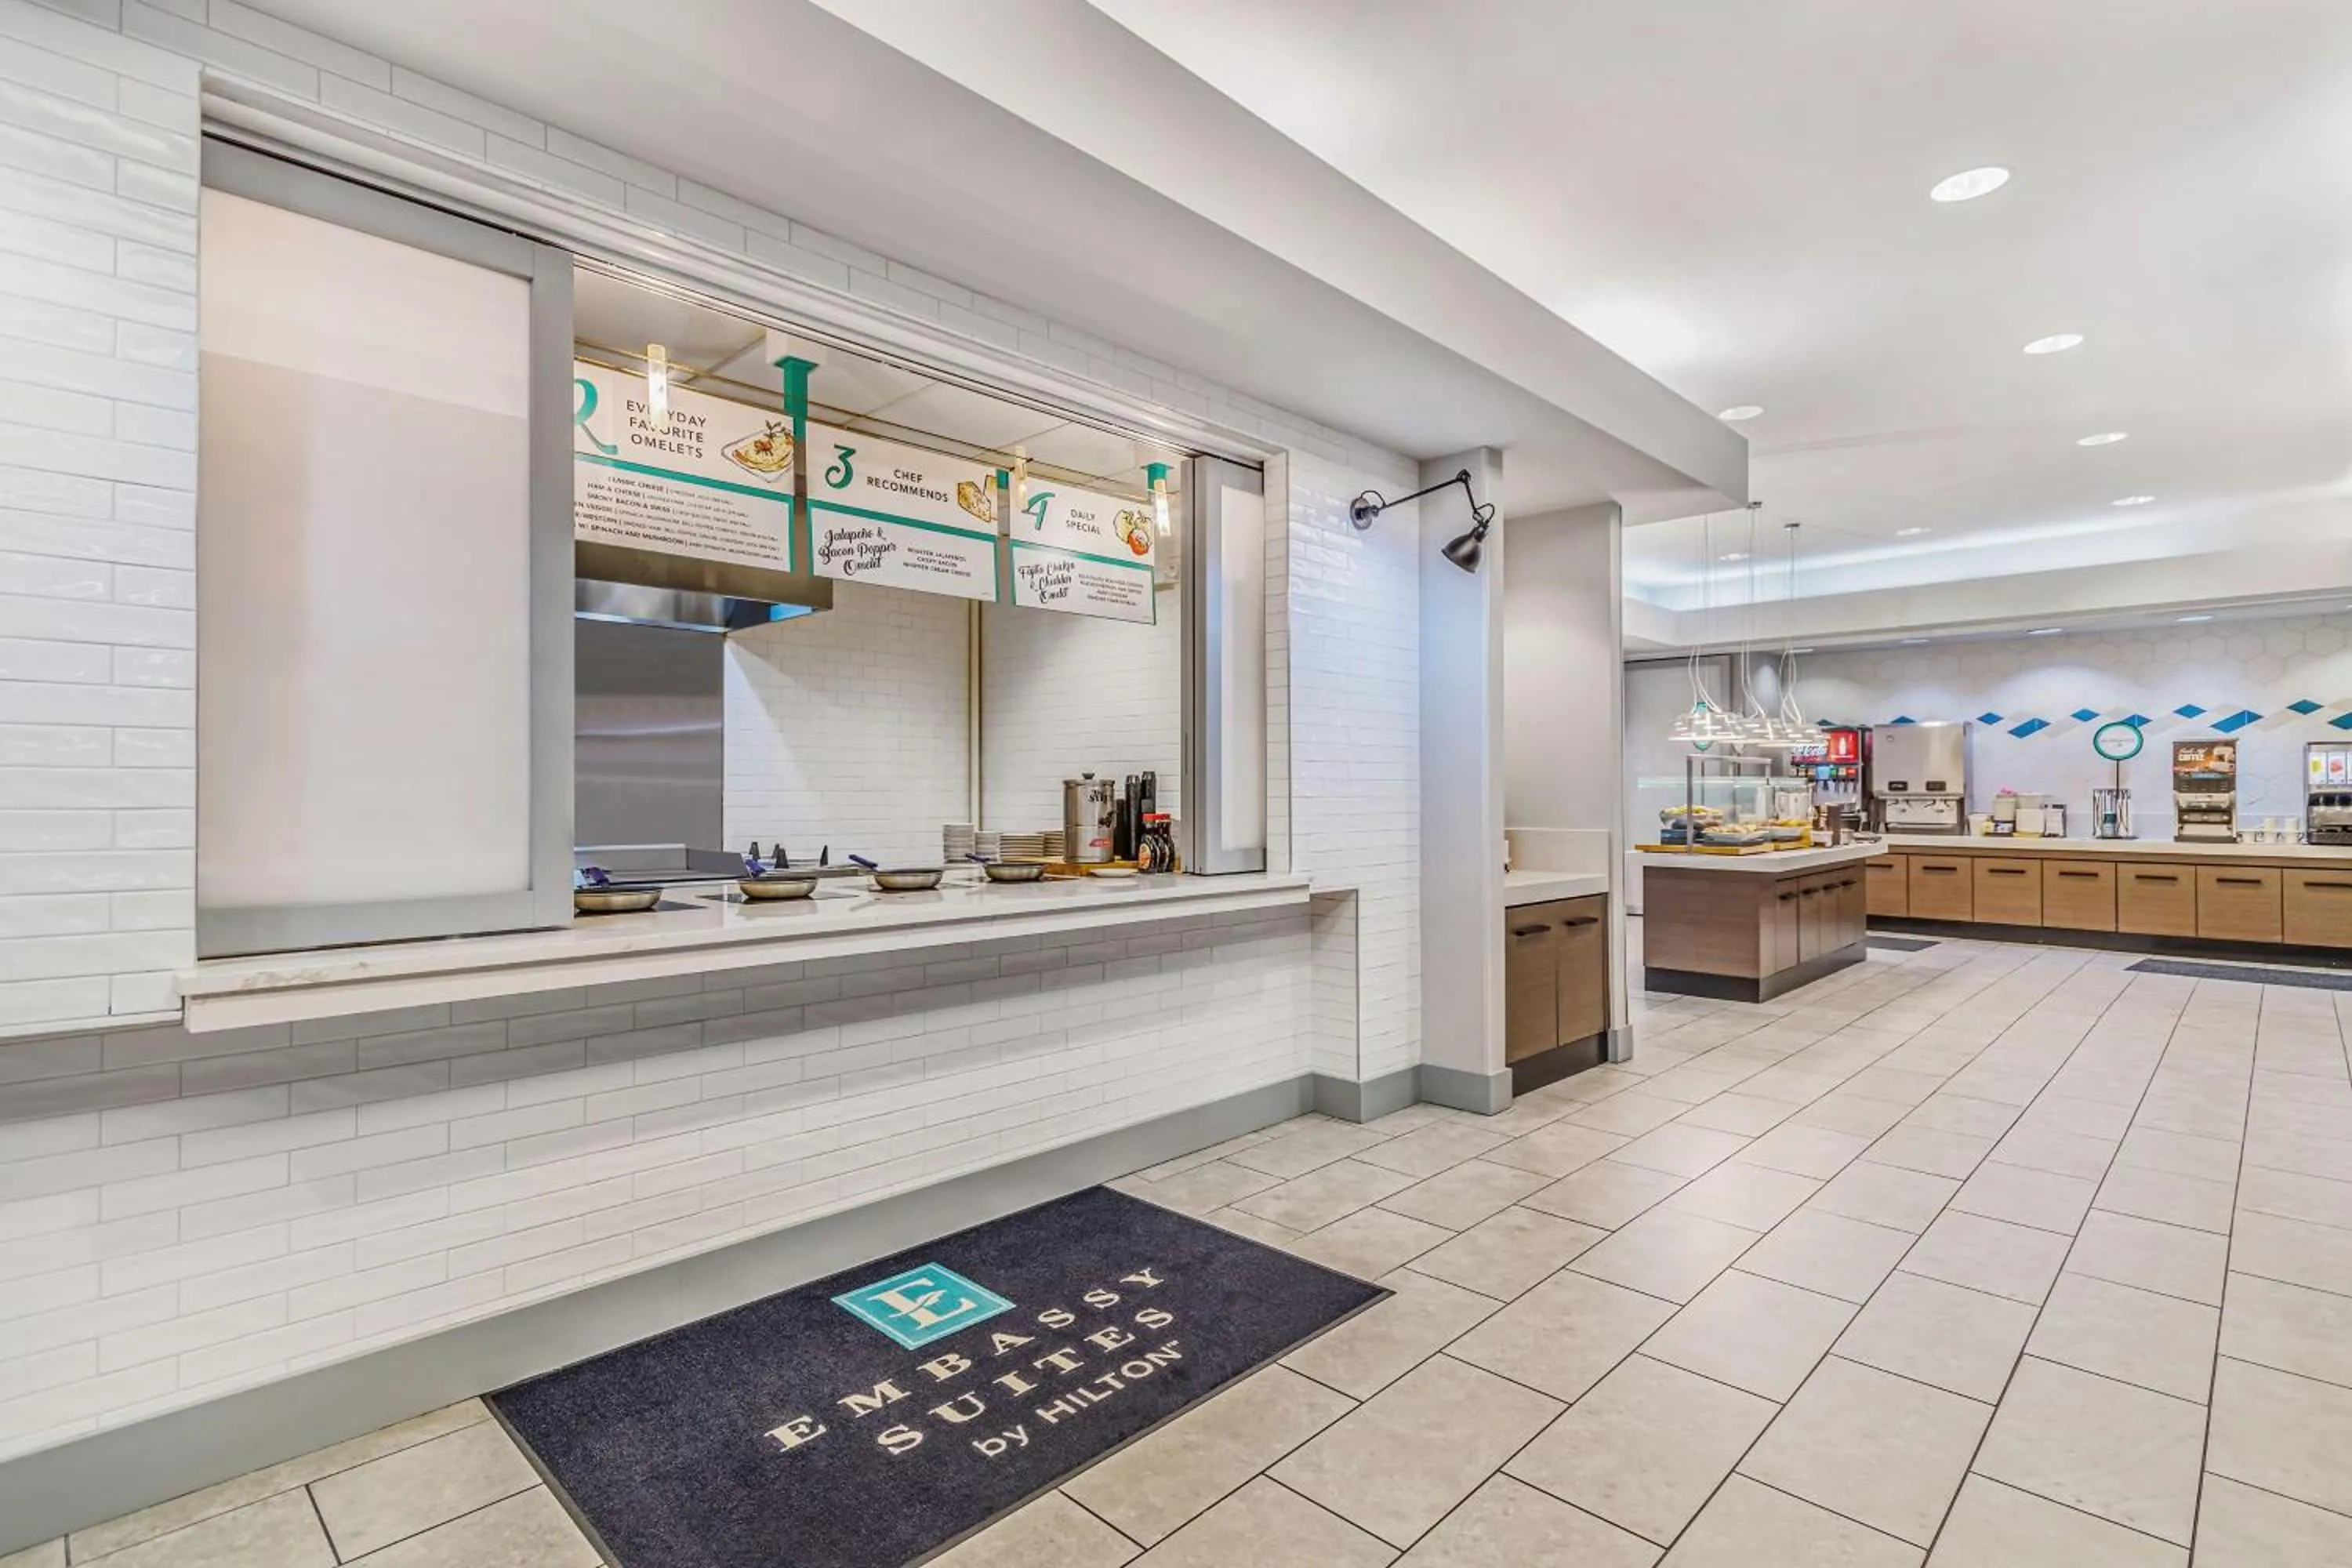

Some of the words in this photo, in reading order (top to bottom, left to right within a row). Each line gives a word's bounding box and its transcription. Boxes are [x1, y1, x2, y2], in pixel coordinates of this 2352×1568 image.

[626, 400, 706, 427] EVYDAY
[631, 434, 703, 459] OMELETS
[825, 443, 857, 490] 3
[894, 469, 924, 484] CHEF
[866, 477, 949, 503] RECOMMENDS
[1065, 520, 1102, 535] SPECIAL
[1070, 510, 1096, 521] DAILY
[818, 544, 855, 564] Bacon
[764, 1267, 1164, 1452] EMBASSY
[877, 1308, 1174, 1455] SUITES
[971, 1424, 1029, 1457] by
